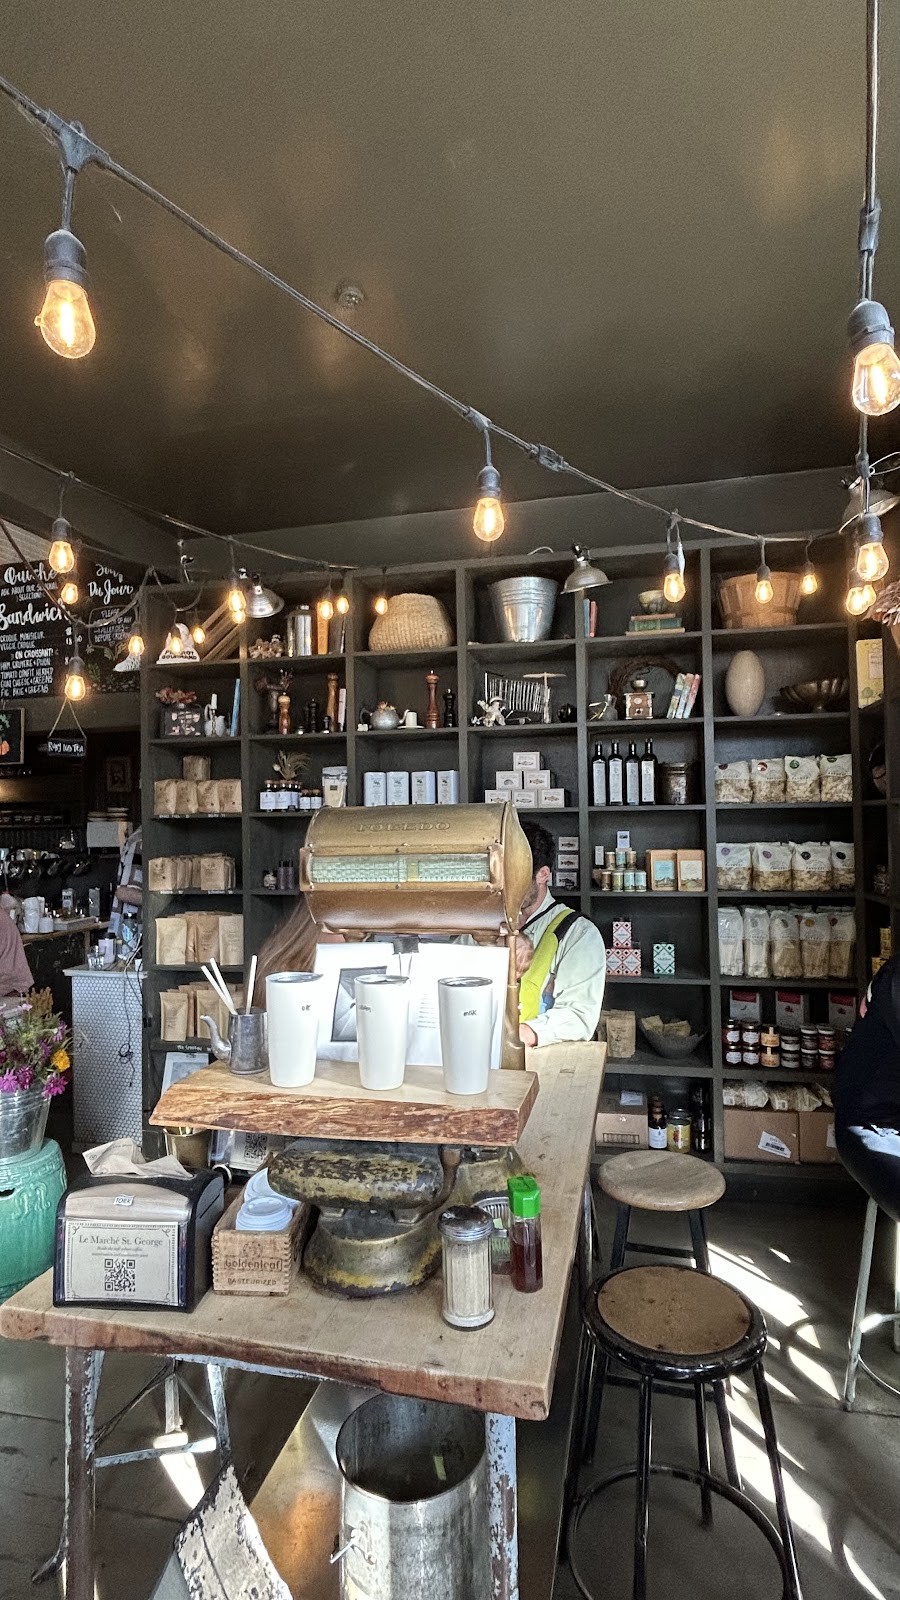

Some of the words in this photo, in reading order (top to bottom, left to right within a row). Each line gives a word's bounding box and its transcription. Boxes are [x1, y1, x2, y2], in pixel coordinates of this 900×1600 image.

[356, 822, 451, 833] TOLEDO
[78, 1235, 89, 1243] Le
[90, 1235, 120, 1245] Marché
[121, 1237, 132, 1245] St.
[134, 1237, 164, 1247] George
[225, 1258, 280, 1270] Goldenleaf
[227, 1277, 277, 1286] PASTEURIZED
